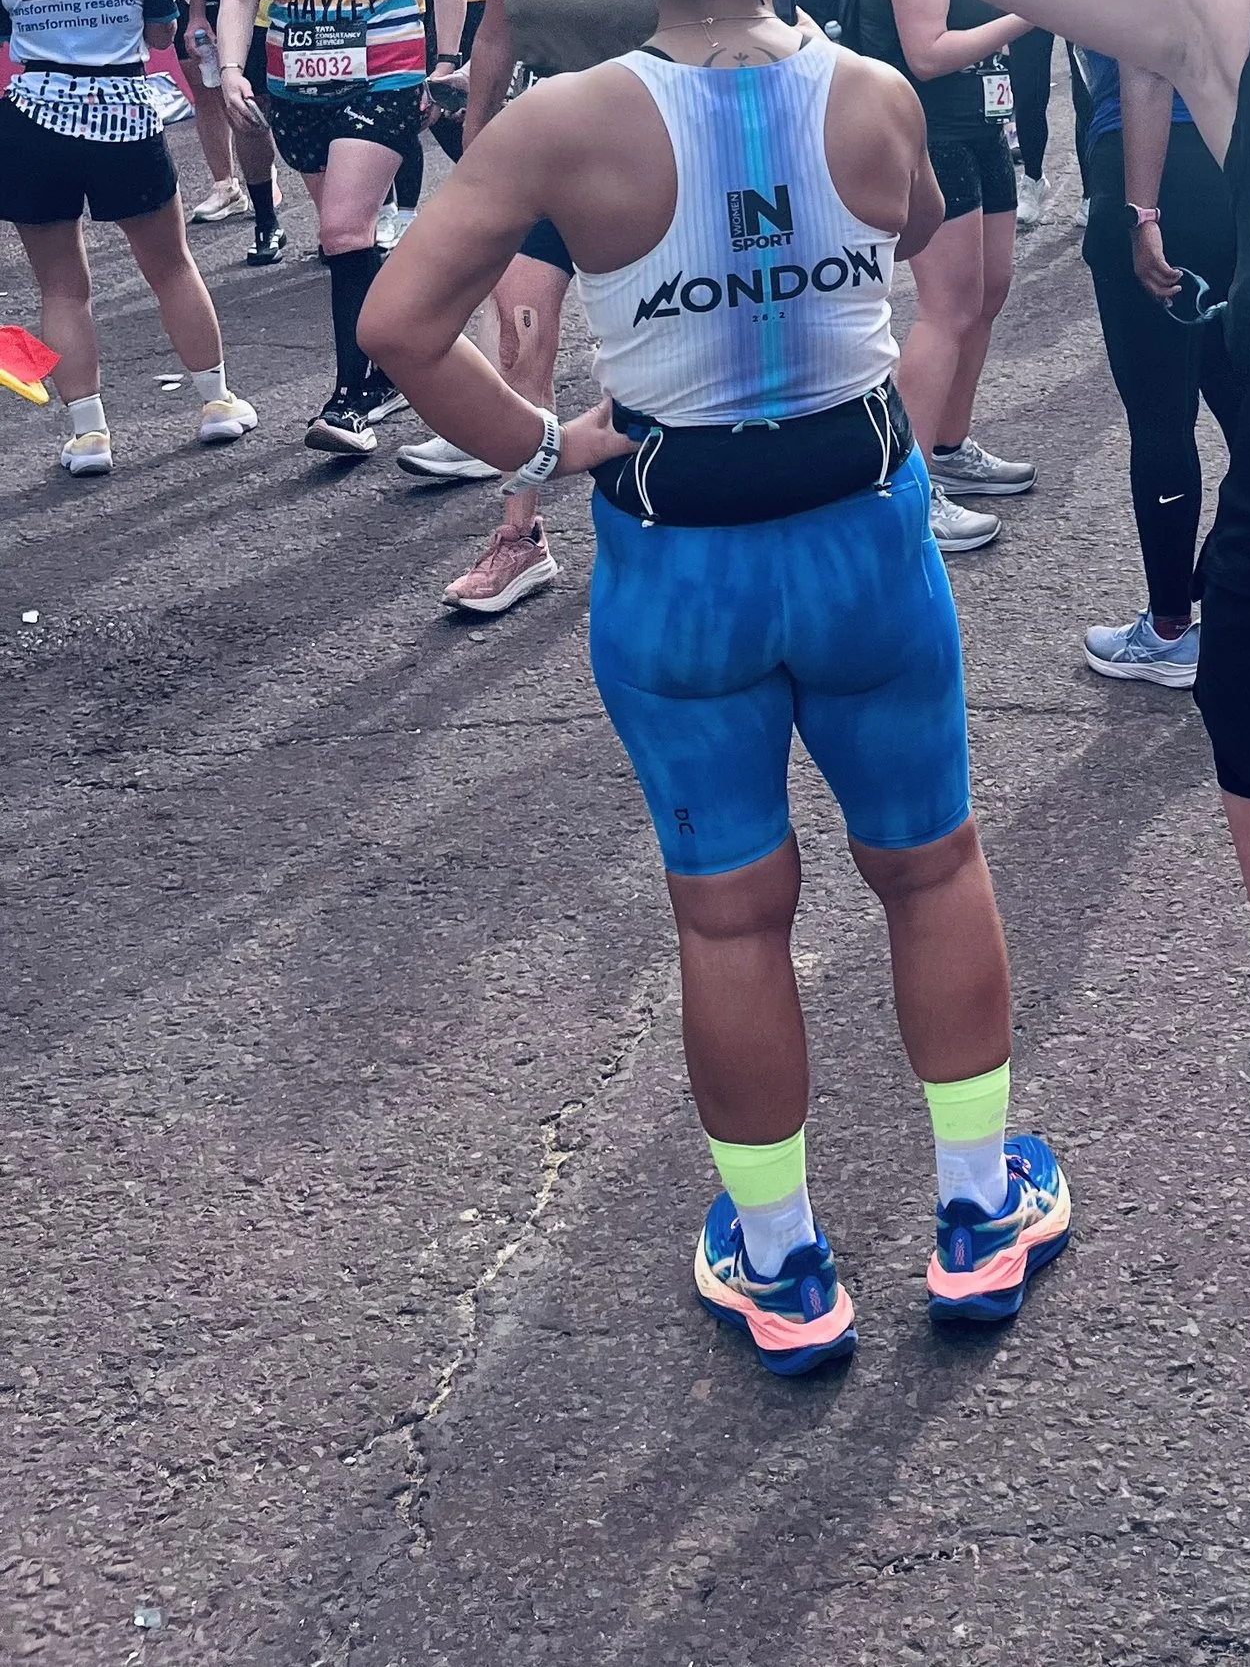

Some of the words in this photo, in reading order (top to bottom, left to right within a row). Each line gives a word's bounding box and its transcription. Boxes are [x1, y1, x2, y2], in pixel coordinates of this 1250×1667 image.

[16, 15, 98, 33] Transforming
[288, 28, 312, 47] tcs
[295, 56, 352, 78] 26032
[731, 193, 743, 236] WOMEN
[732, 232, 794, 252] SPORT
[633, 245, 883, 328] LONDON
